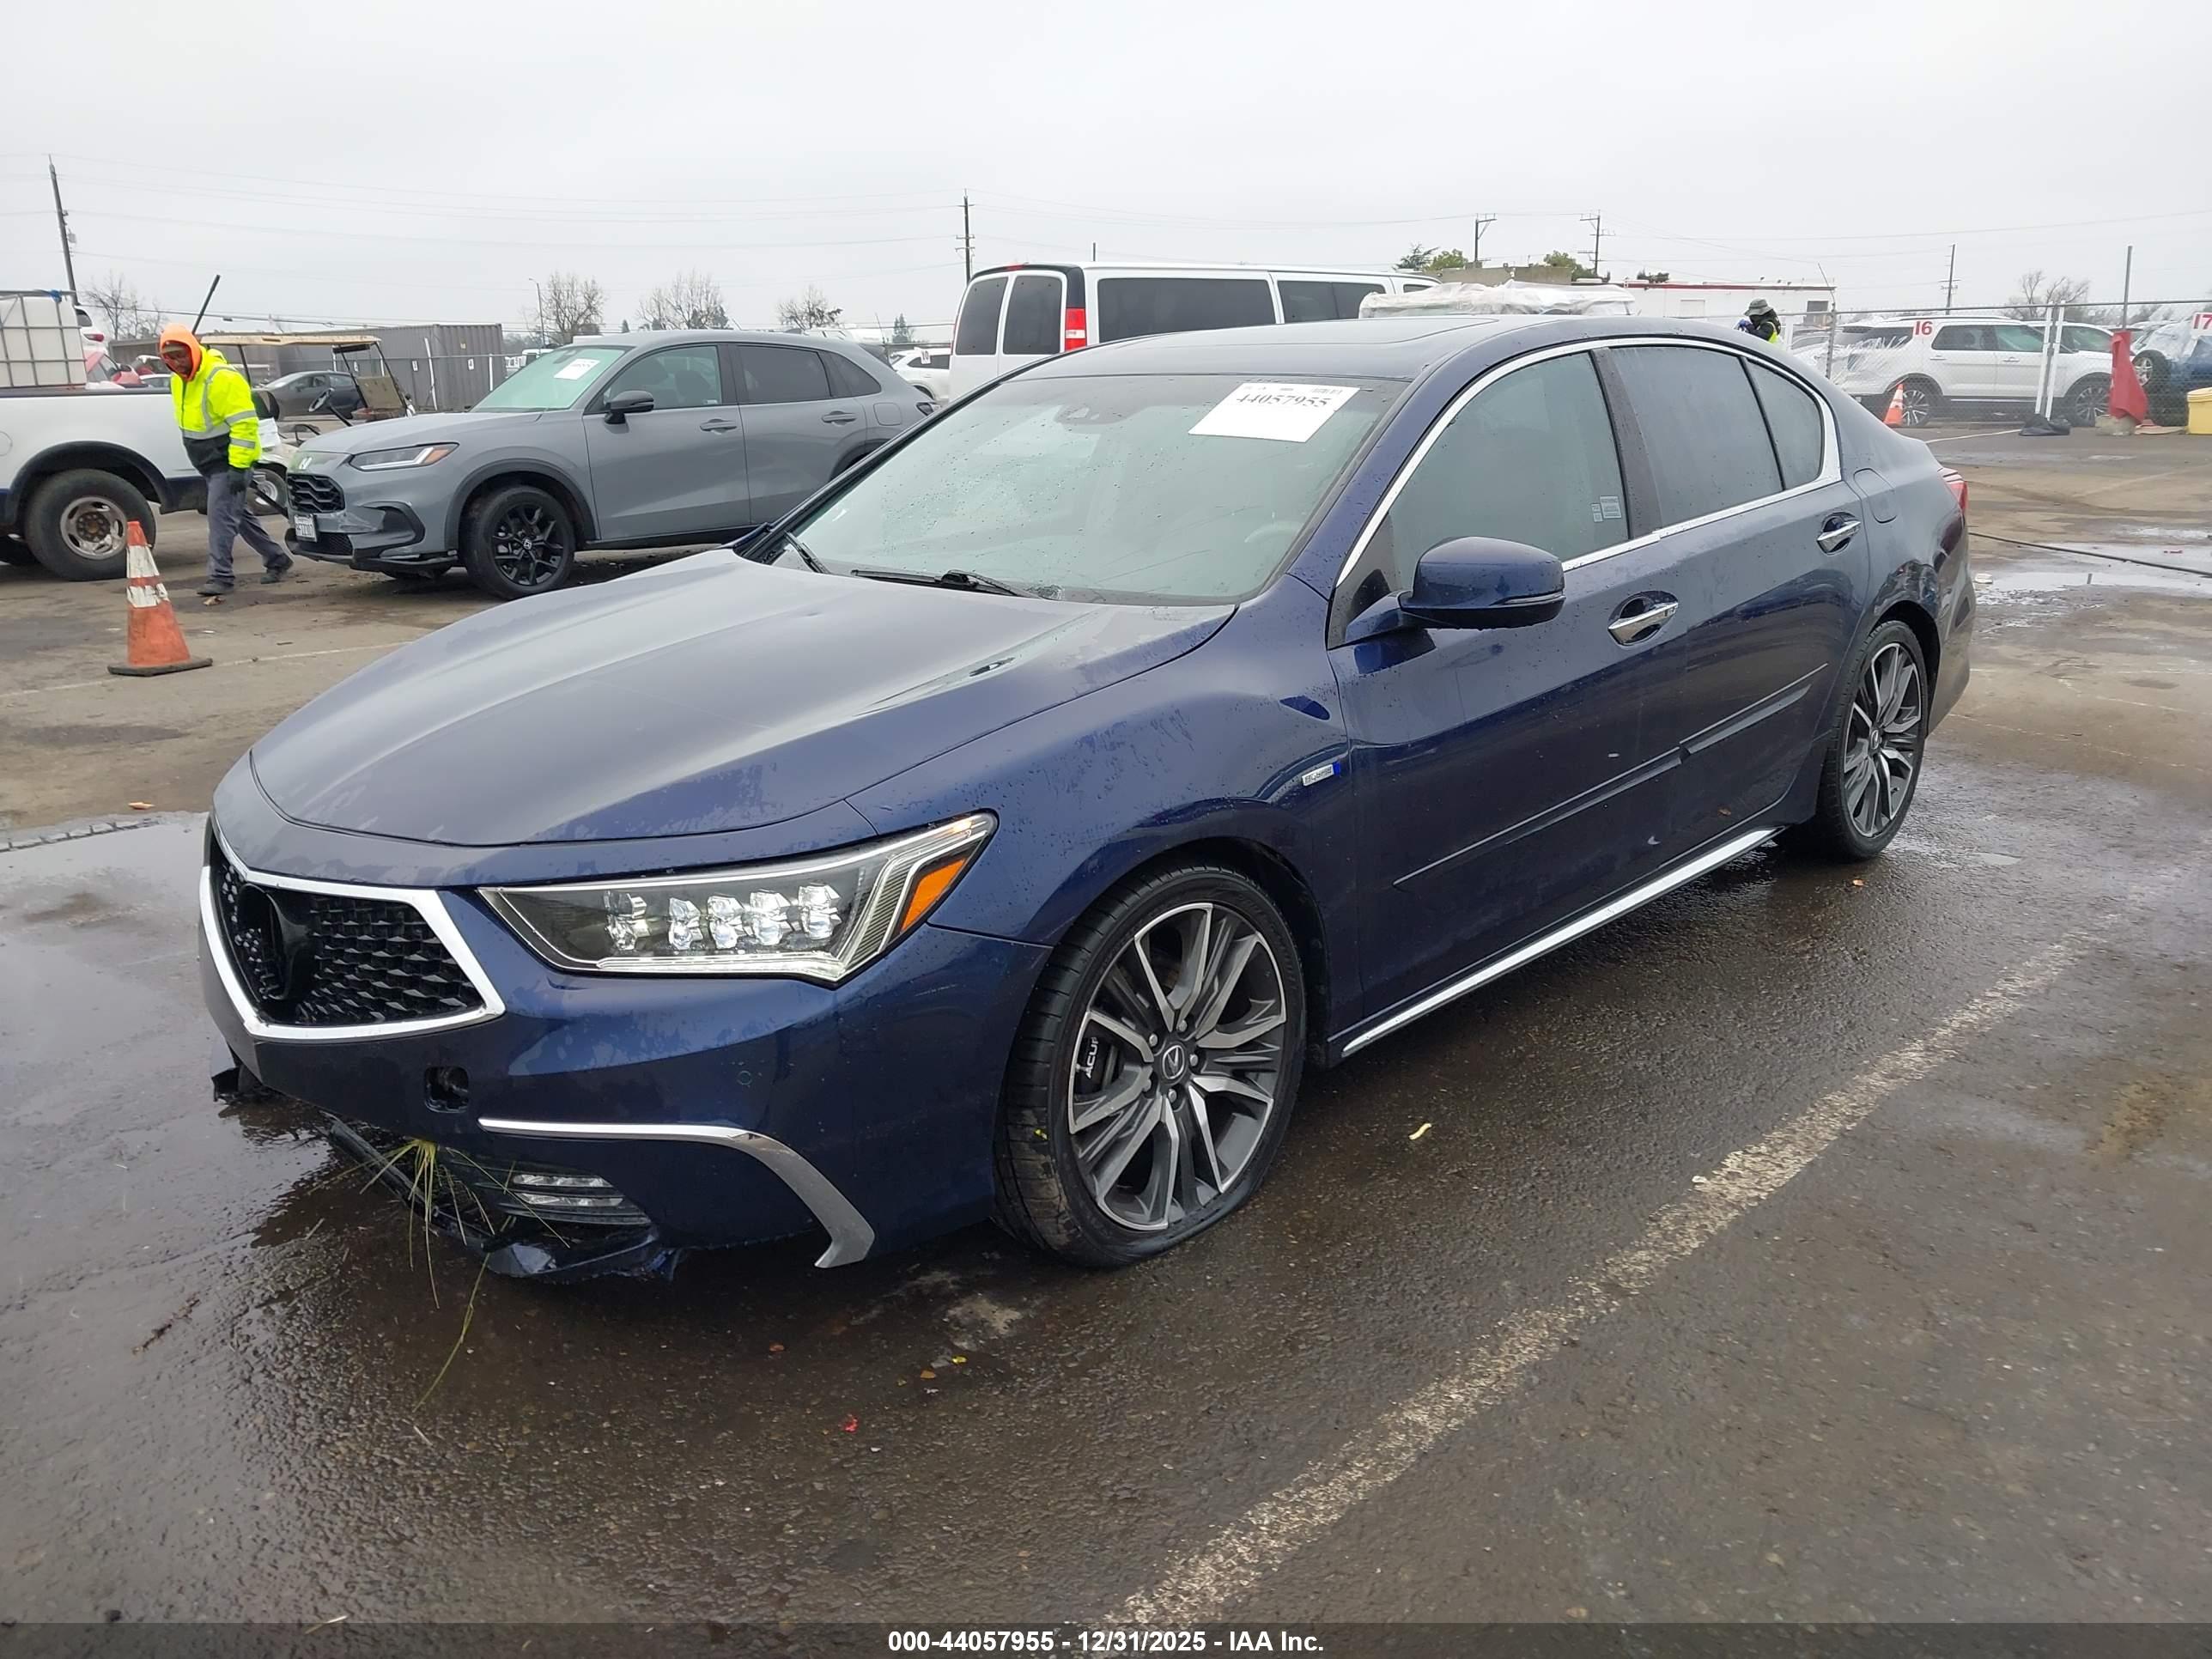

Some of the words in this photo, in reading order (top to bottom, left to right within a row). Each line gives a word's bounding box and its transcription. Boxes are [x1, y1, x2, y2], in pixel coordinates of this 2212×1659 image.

[1915, 321, 1933, 335] 16
[2193, 313, 2212, 330] 17
[1236, 393, 1332, 408] 44057955
[1304, 765, 1333, 783] Hybrid
